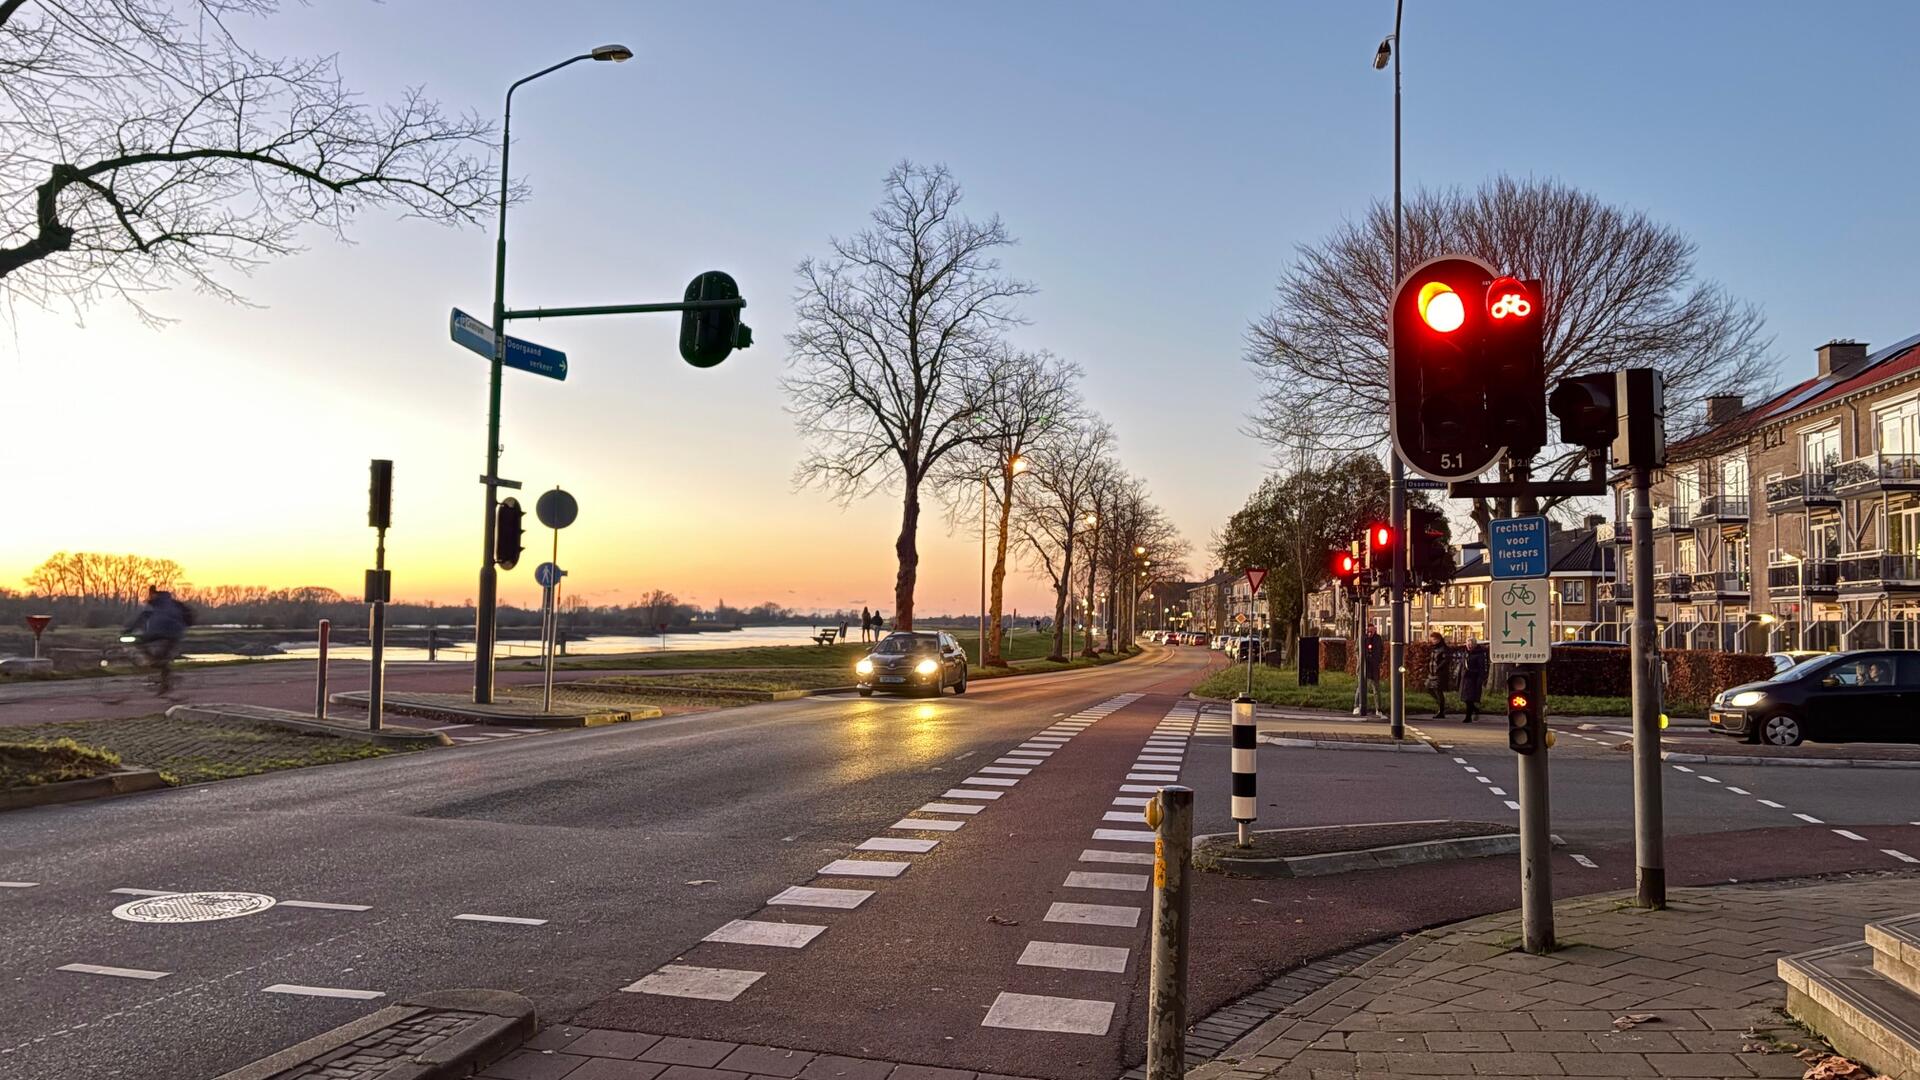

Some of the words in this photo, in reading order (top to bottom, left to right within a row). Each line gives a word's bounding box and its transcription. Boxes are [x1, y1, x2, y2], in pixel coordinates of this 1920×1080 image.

[507, 339, 542, 357] Doorgaand
[529, 360, 553, 372] verkeer
[1440, 453, 1463, 469] 5.1
[1495, 521, 1539, 533] rechtsaf
[1506, 537, 1529, 545] voor
[1498, 549, 1539, 559] fietsers
[1510, 561, 1528, 574] vrij
